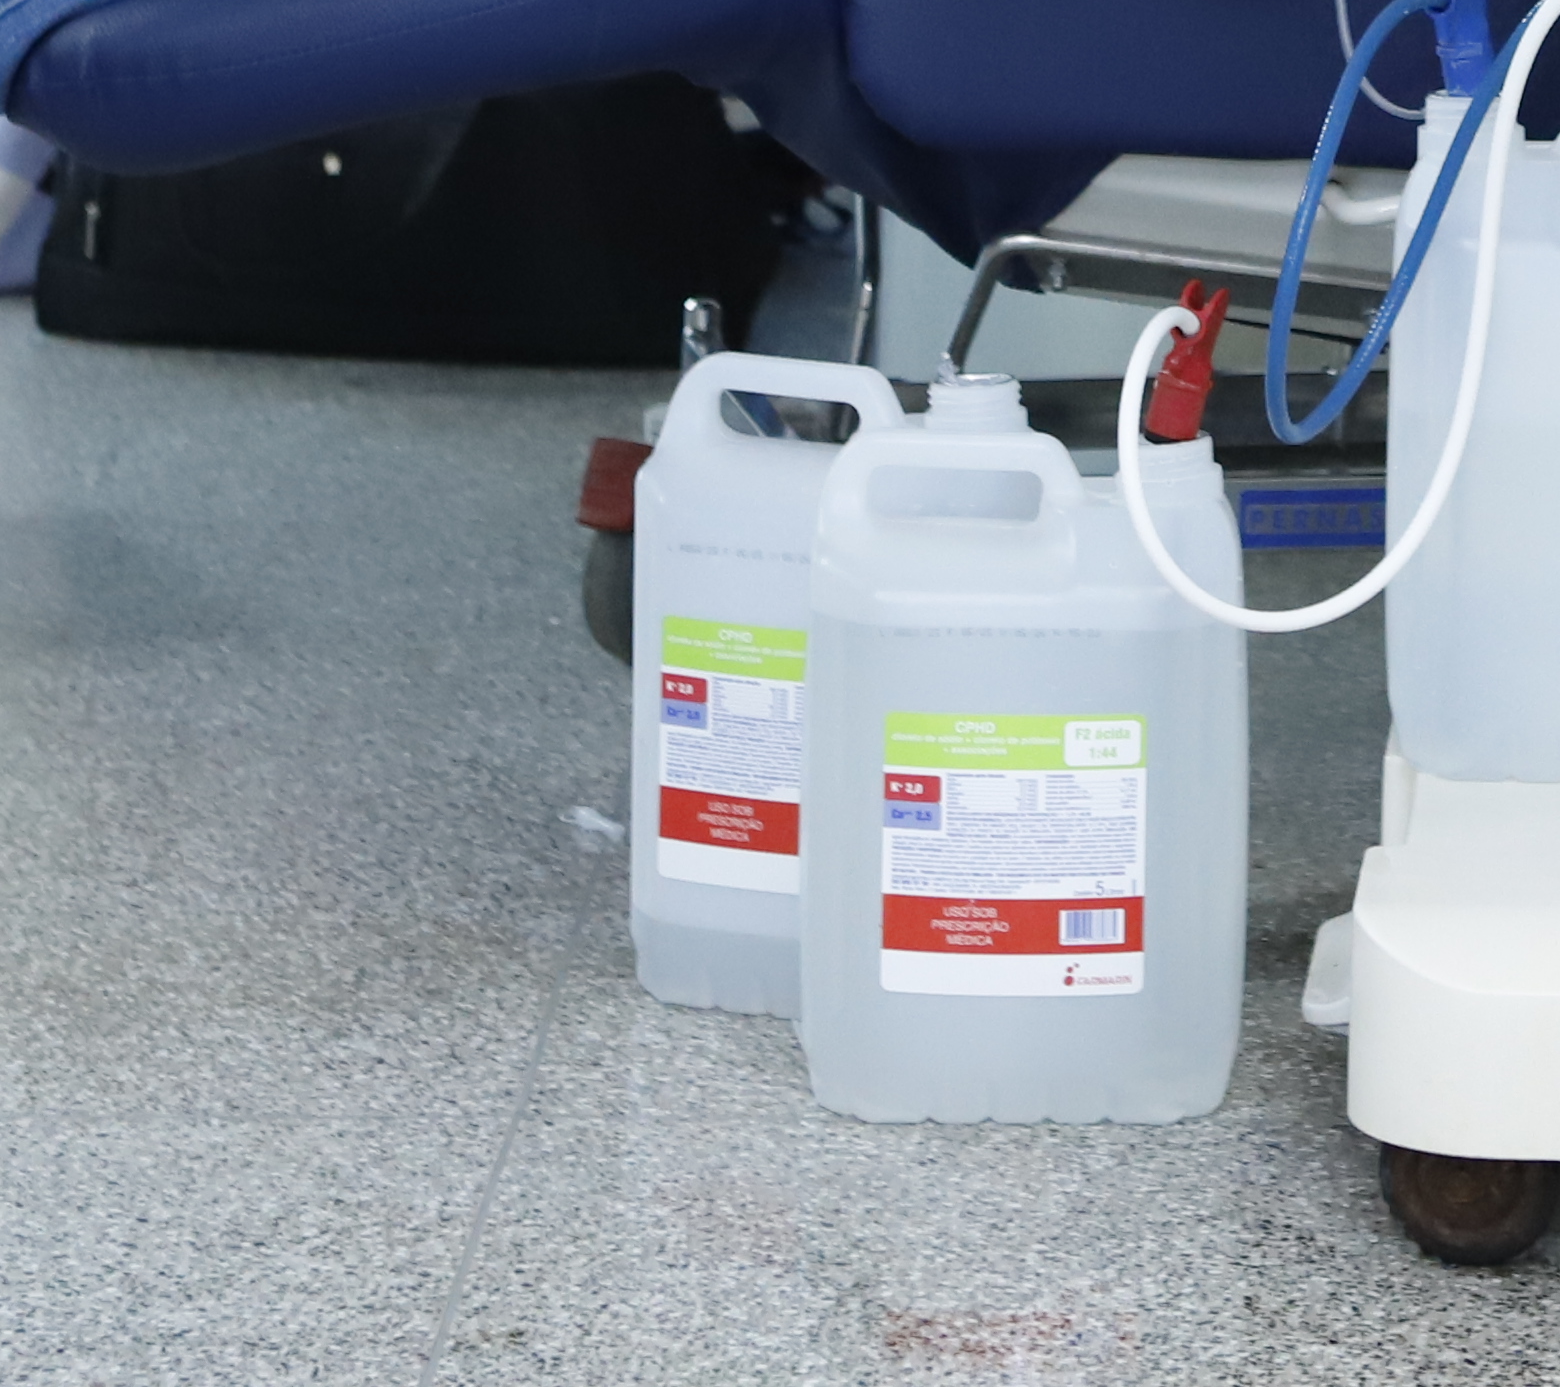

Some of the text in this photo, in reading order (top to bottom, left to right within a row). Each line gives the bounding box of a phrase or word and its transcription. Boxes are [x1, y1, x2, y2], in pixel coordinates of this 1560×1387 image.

[1250, 508, 1385, 532] PERNAS
[954, 720, 997, 734] CPHD
[1075, 728, 1091, 740] F2
[1089, 747, 1118, 758] 1:44
[971, 907, 998, 919] SOB
